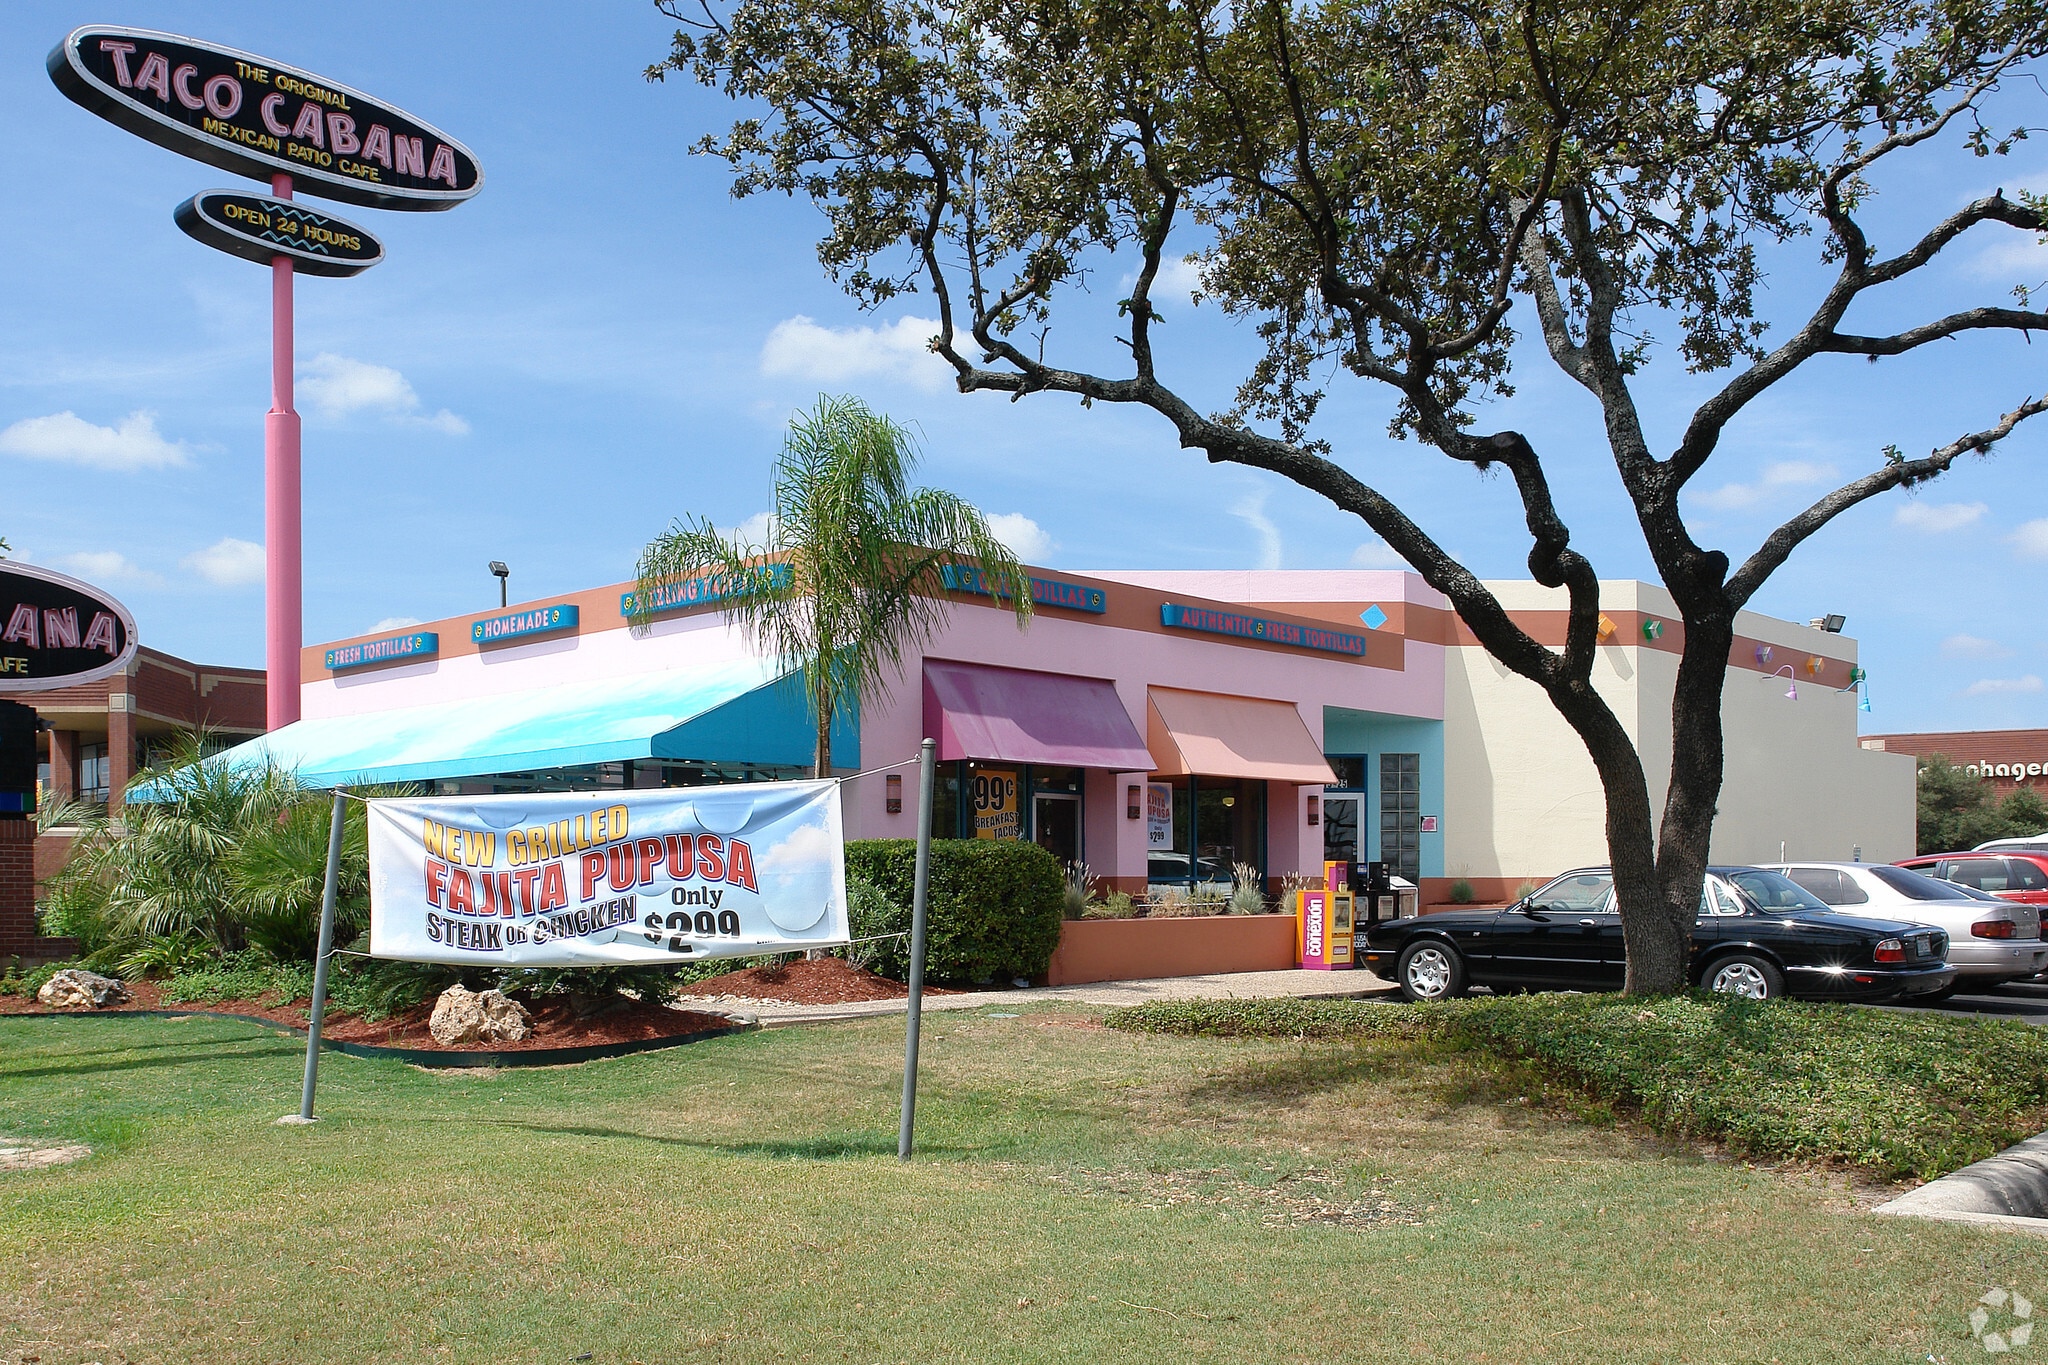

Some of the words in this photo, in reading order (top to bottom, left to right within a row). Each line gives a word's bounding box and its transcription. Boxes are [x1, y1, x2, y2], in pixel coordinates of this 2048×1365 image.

[234, 61, 270, 84] THE
[275, 75, 351, 111] ORIGINAL
[100, 40, 243, 119] TACO
[261, 92, 458, 188] CABANA
[202, 117, 280, 152] MEXICAN
[287, 142, 332, 168] PATIO
[339, 159, 382, 183] CAFE
[224, 204, 271, 228] OPEN
[277, 217, 299, 235] 24
[304, 224, 361, 251] HOURS
[0, 603, 118, 657] ANA
[484, 610, 549, 638] HOMEMADE
[1181, 608, 1253, 635] AUTHENTIC
[1265, 621, 1300, 643] FRESH
[1304, 629, 1362, 653] TORTILLAS
[334, 649, 360, 665] FRESH
[363, 636, 413, 659] TORTILLAS
[974, 775, 1014, 812] 99¢
[423, 818, 496, 867] NEW
[506, 804, 629, 866] GRILLED
[974, 811, 1019, 829] BREAKFAST
[993, 825, 1019, 840] TACOS
[425, 856, 568, 918] FAJITA
[580, 833, 760, 903] PUPUSA
[671, 885, 723, 909] Only
[426, 912, 503, 951] STEAK
[506, 925, 527, 945] OR
[532, 893, 637, 944] CHICKEN
